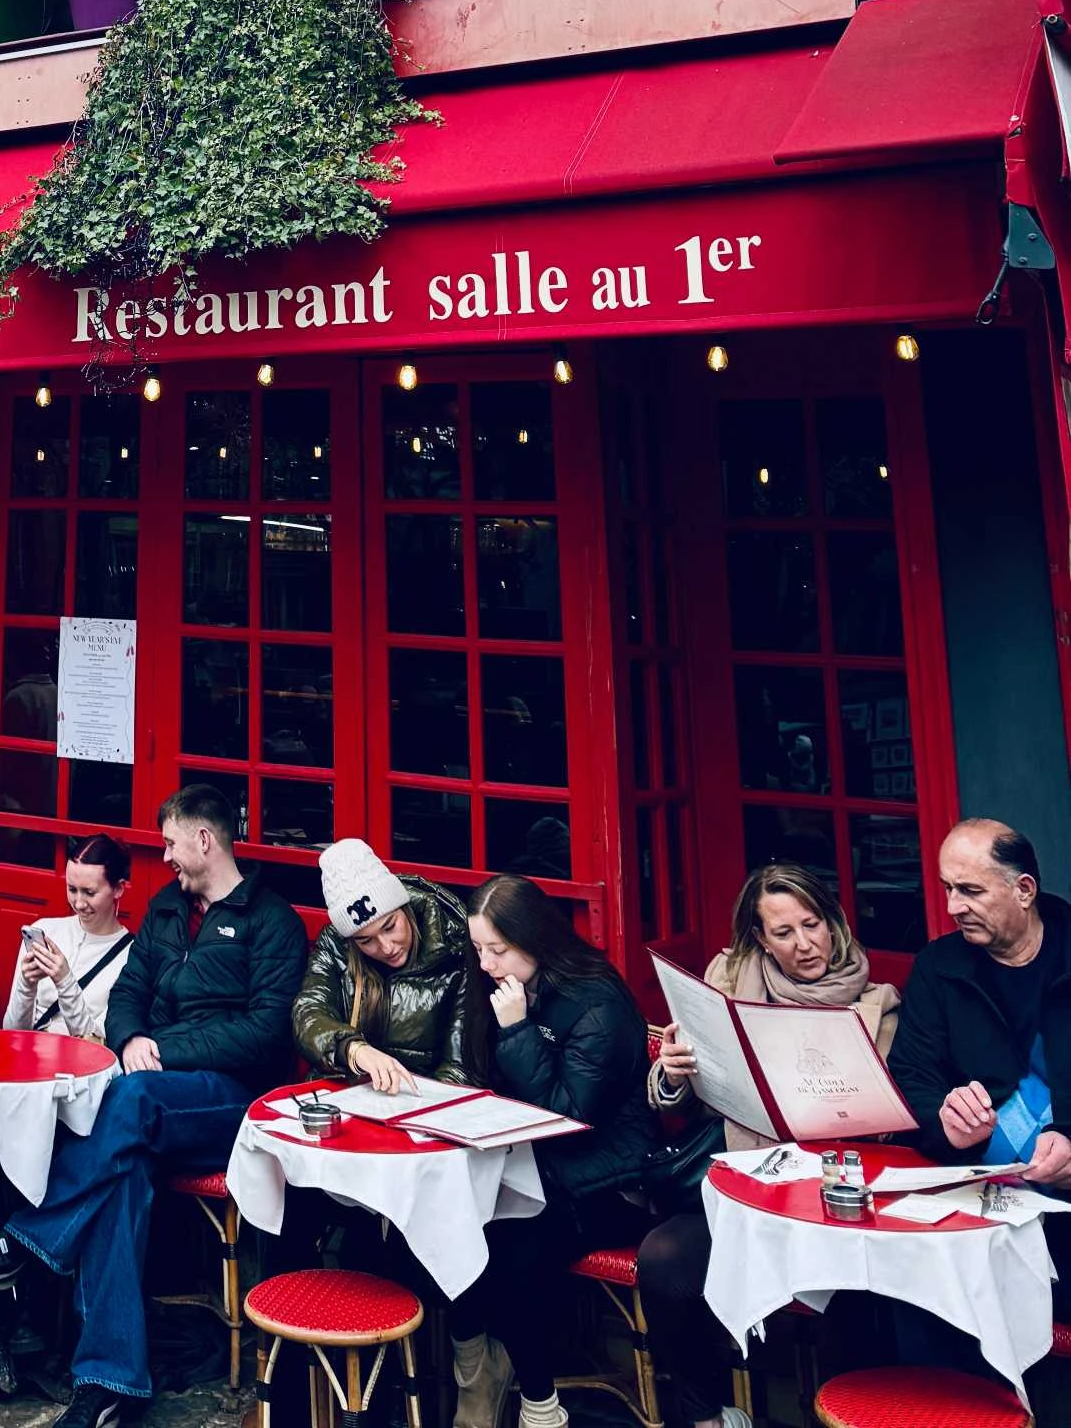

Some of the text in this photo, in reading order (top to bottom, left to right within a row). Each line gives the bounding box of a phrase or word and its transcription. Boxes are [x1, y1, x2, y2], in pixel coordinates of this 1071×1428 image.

[71, 233, 762, 344] Restaurant salle au 1er
